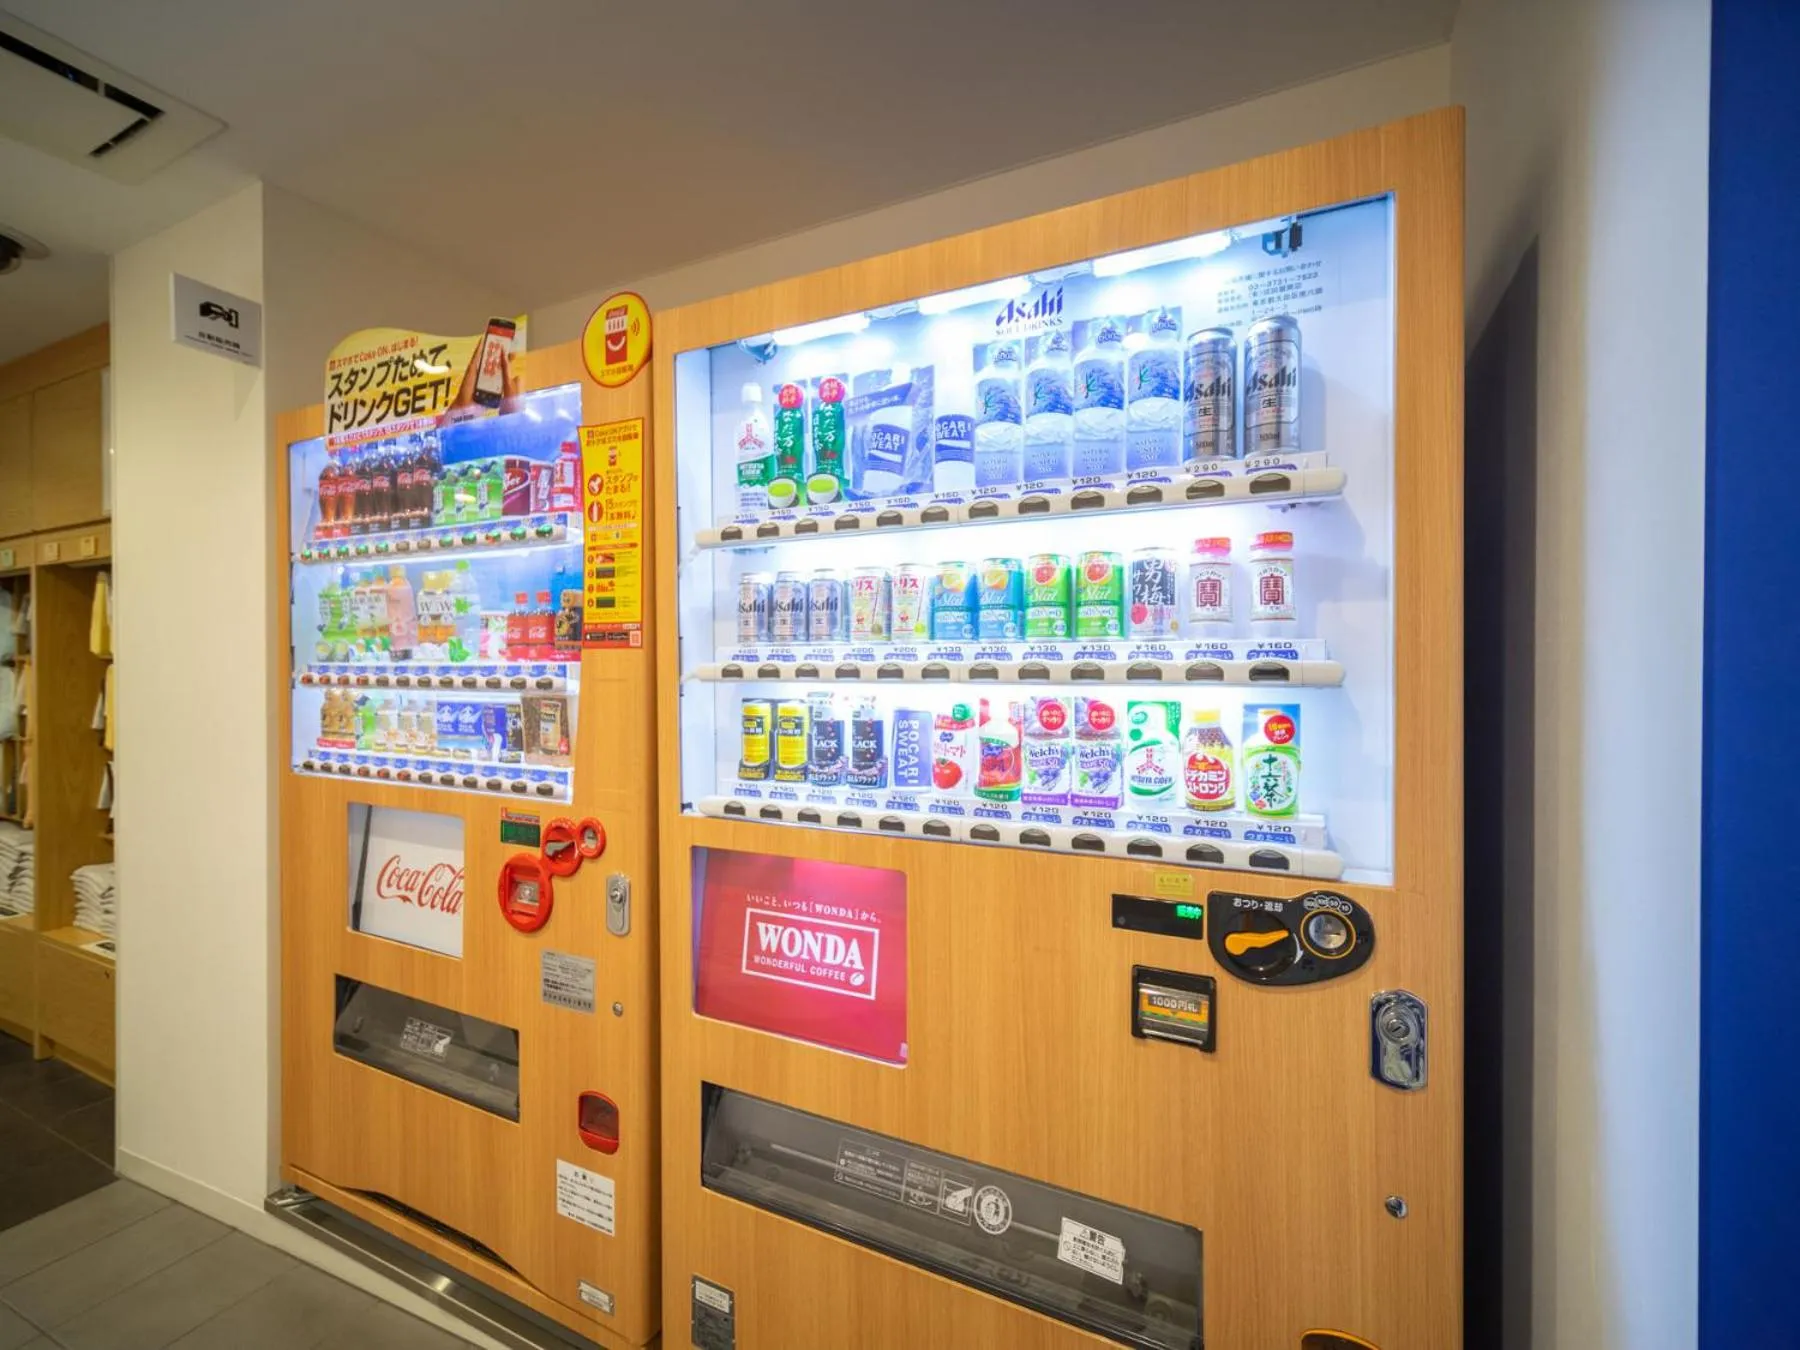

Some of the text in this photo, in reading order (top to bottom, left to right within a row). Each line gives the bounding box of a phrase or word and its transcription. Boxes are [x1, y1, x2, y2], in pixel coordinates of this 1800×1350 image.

[996, 286, 1063, 327] Asahi
[328, 377, 451, 434] ドリンクGET!
[1072, 476, 1101, 485] ¥120
[1127, 470, 1157, 479] ¥120
[970, 487, 997, 495] ¥120
[1016, 482, 1044, 490] ¥120
[1142, 560, 1166, 605] 男梅
[898, 719, 908, 778] SWEAT
[908, 719, 919, 784] POCARI
[1154, 777, 1172, 785] CIDER
[1260, 753, 1284, 809] 十六茶
[1137, 815, 1168, 823] ¥120
[1195, 819, 1227, 827] ¥120
[1257, 825, 1292, 833] ¥120
[1233, 897, 1284, 913] おつり・返却
[757, 921, 864, 970] WONDA
[754, 955, 846, 982] WONDERFUL COFFEE
[1152, 996, 1198, 1013] 1000円札
